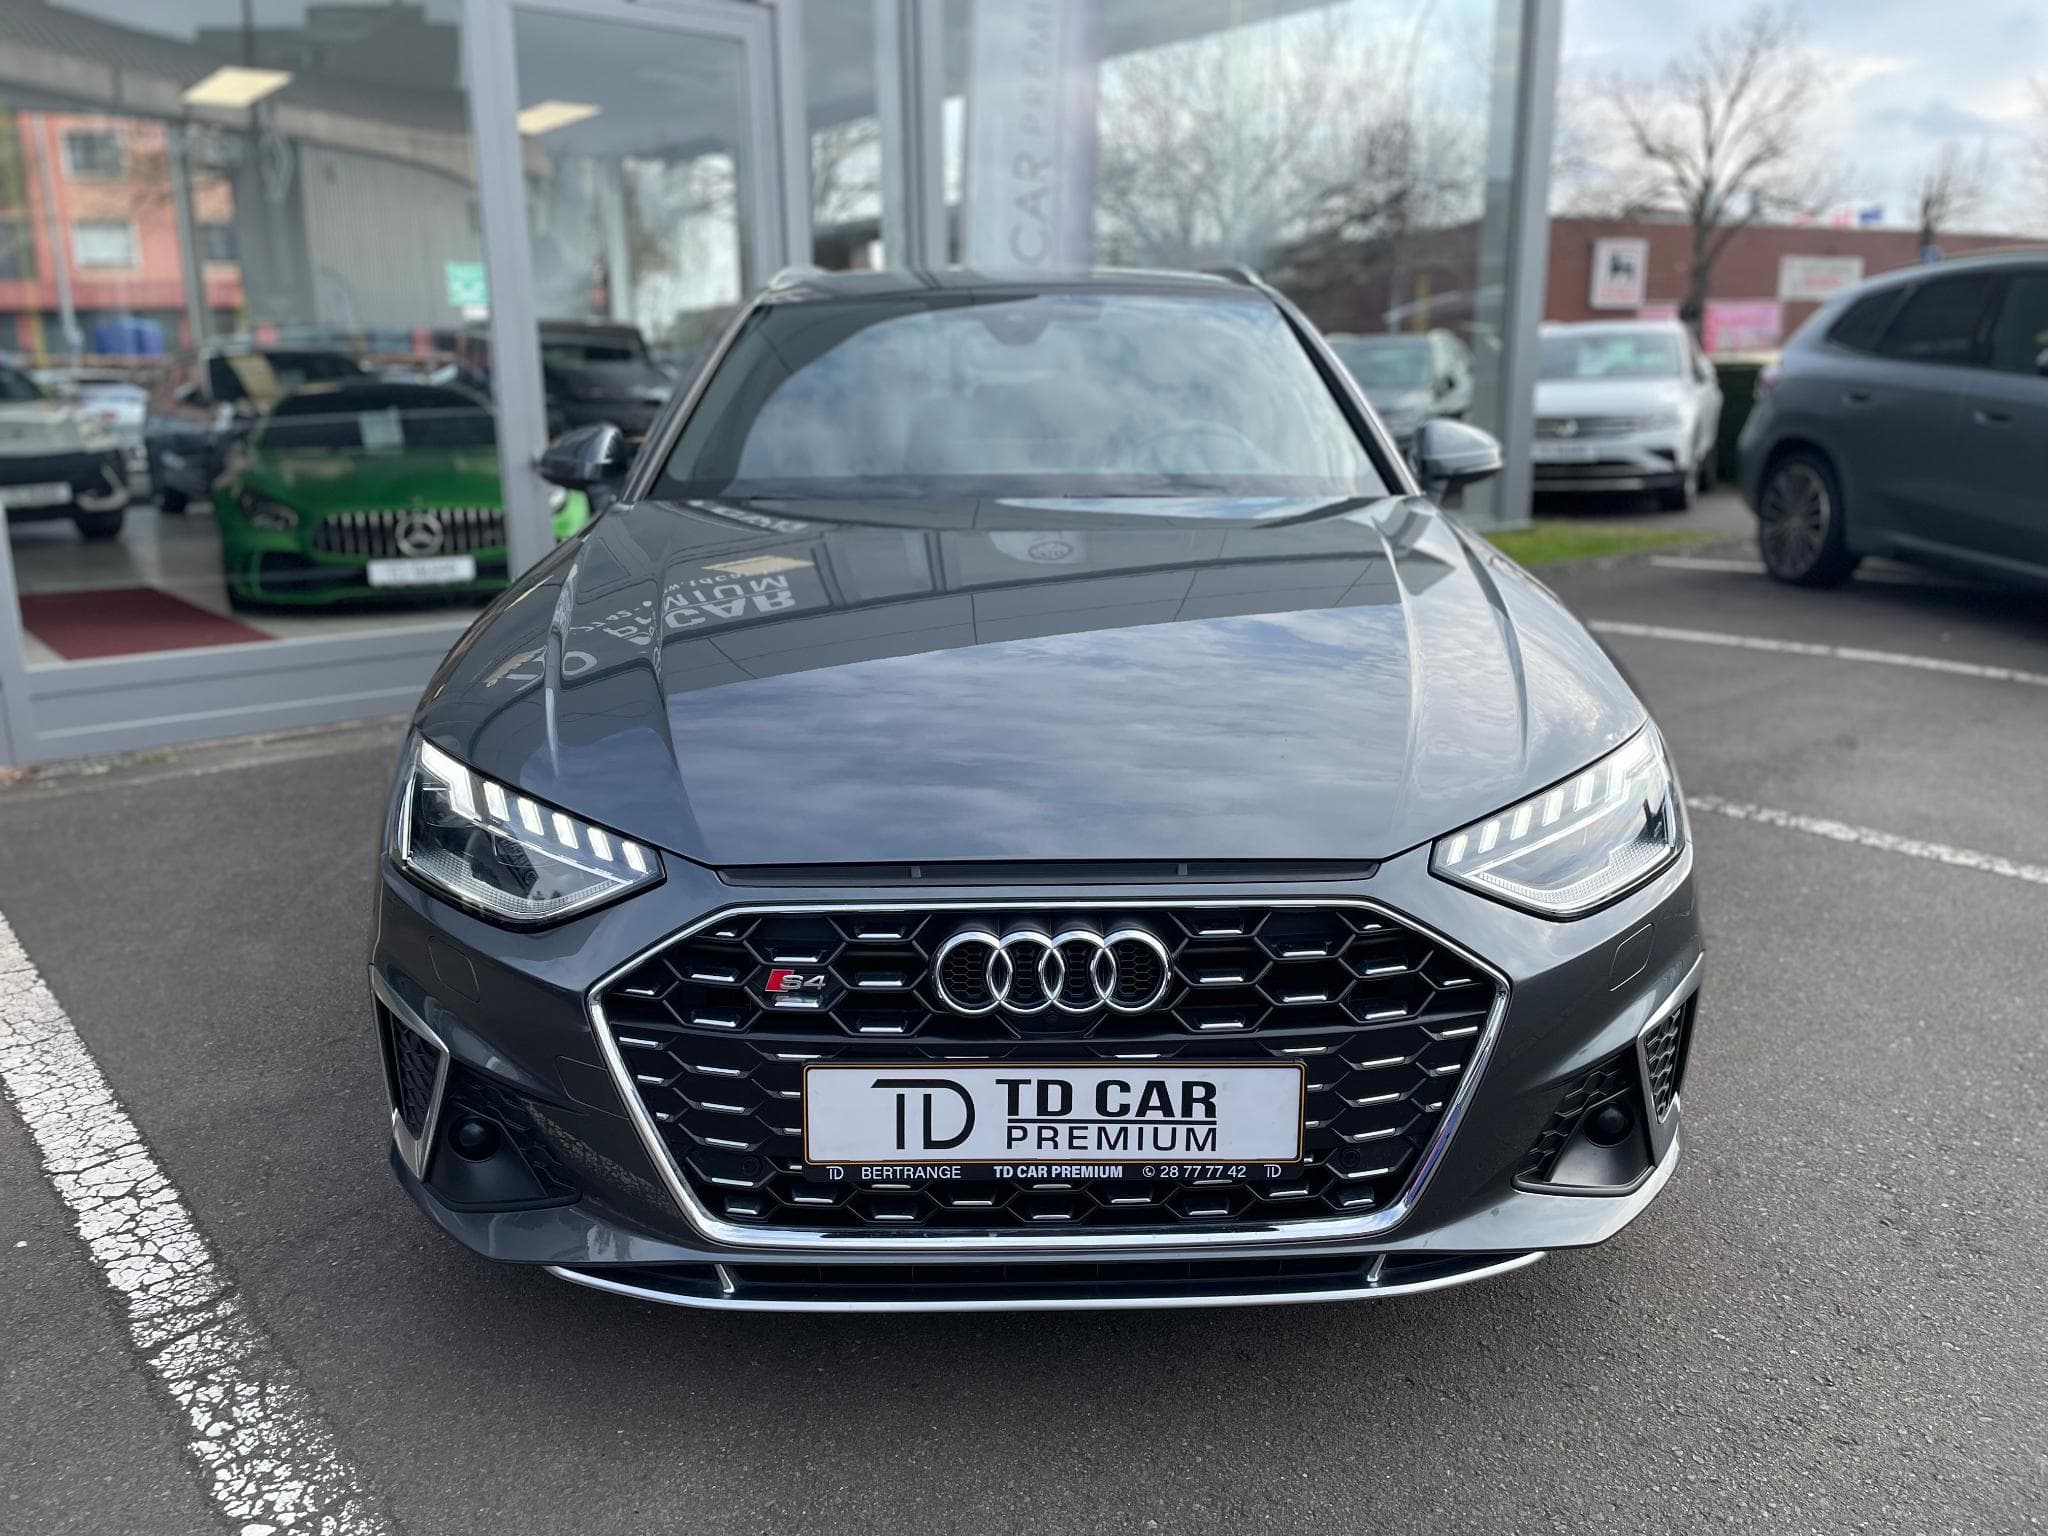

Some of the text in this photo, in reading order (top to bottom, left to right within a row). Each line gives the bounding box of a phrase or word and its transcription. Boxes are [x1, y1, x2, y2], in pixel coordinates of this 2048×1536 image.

[1009, 151, 1051, 264] CAR
[780, 974, 826, 990] S4
[995, 1079, 1217, 1119] TD CAR
[1006, 1125, 1217, 1151] PREMIUM
[861, 1166, 962, 1179] BERTRANGE
[993, 1165, 1123, 1178] TD CAR PREMIUM
[1160, 1165, 1247, 1178] 28 77 77 42
